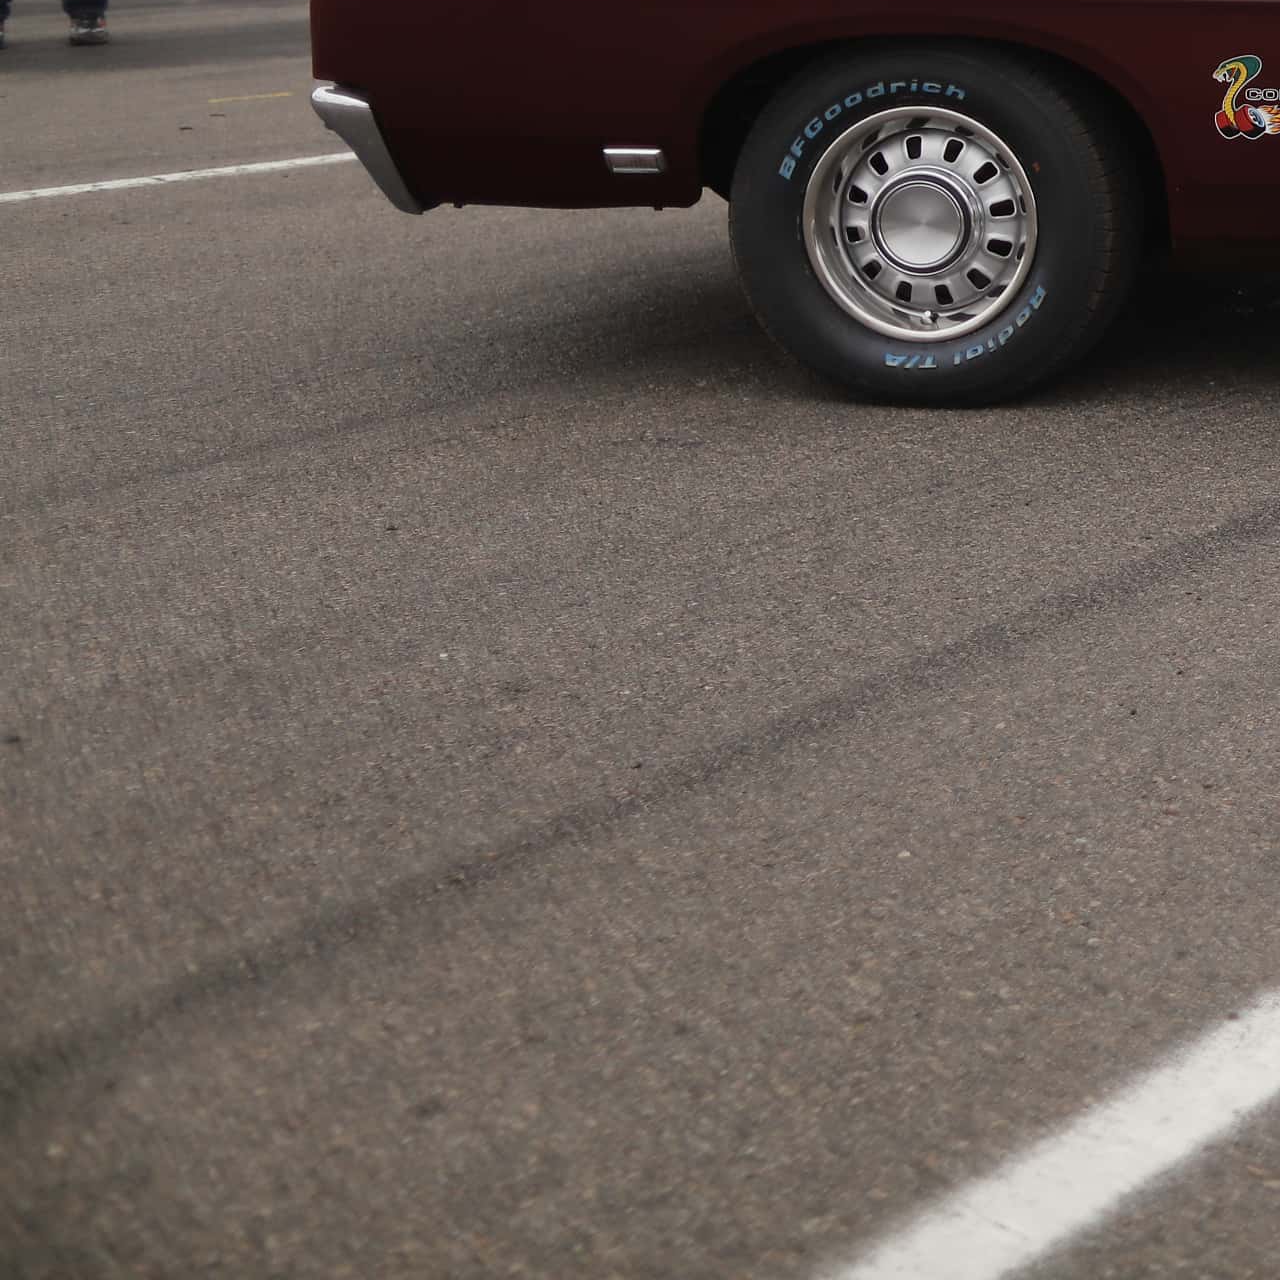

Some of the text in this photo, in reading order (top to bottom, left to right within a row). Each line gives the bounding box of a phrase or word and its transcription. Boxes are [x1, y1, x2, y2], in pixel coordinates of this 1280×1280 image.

[778, 79, 966, 180] BFGoodrich
[884, 286, 1047, 369] Radial T/A
